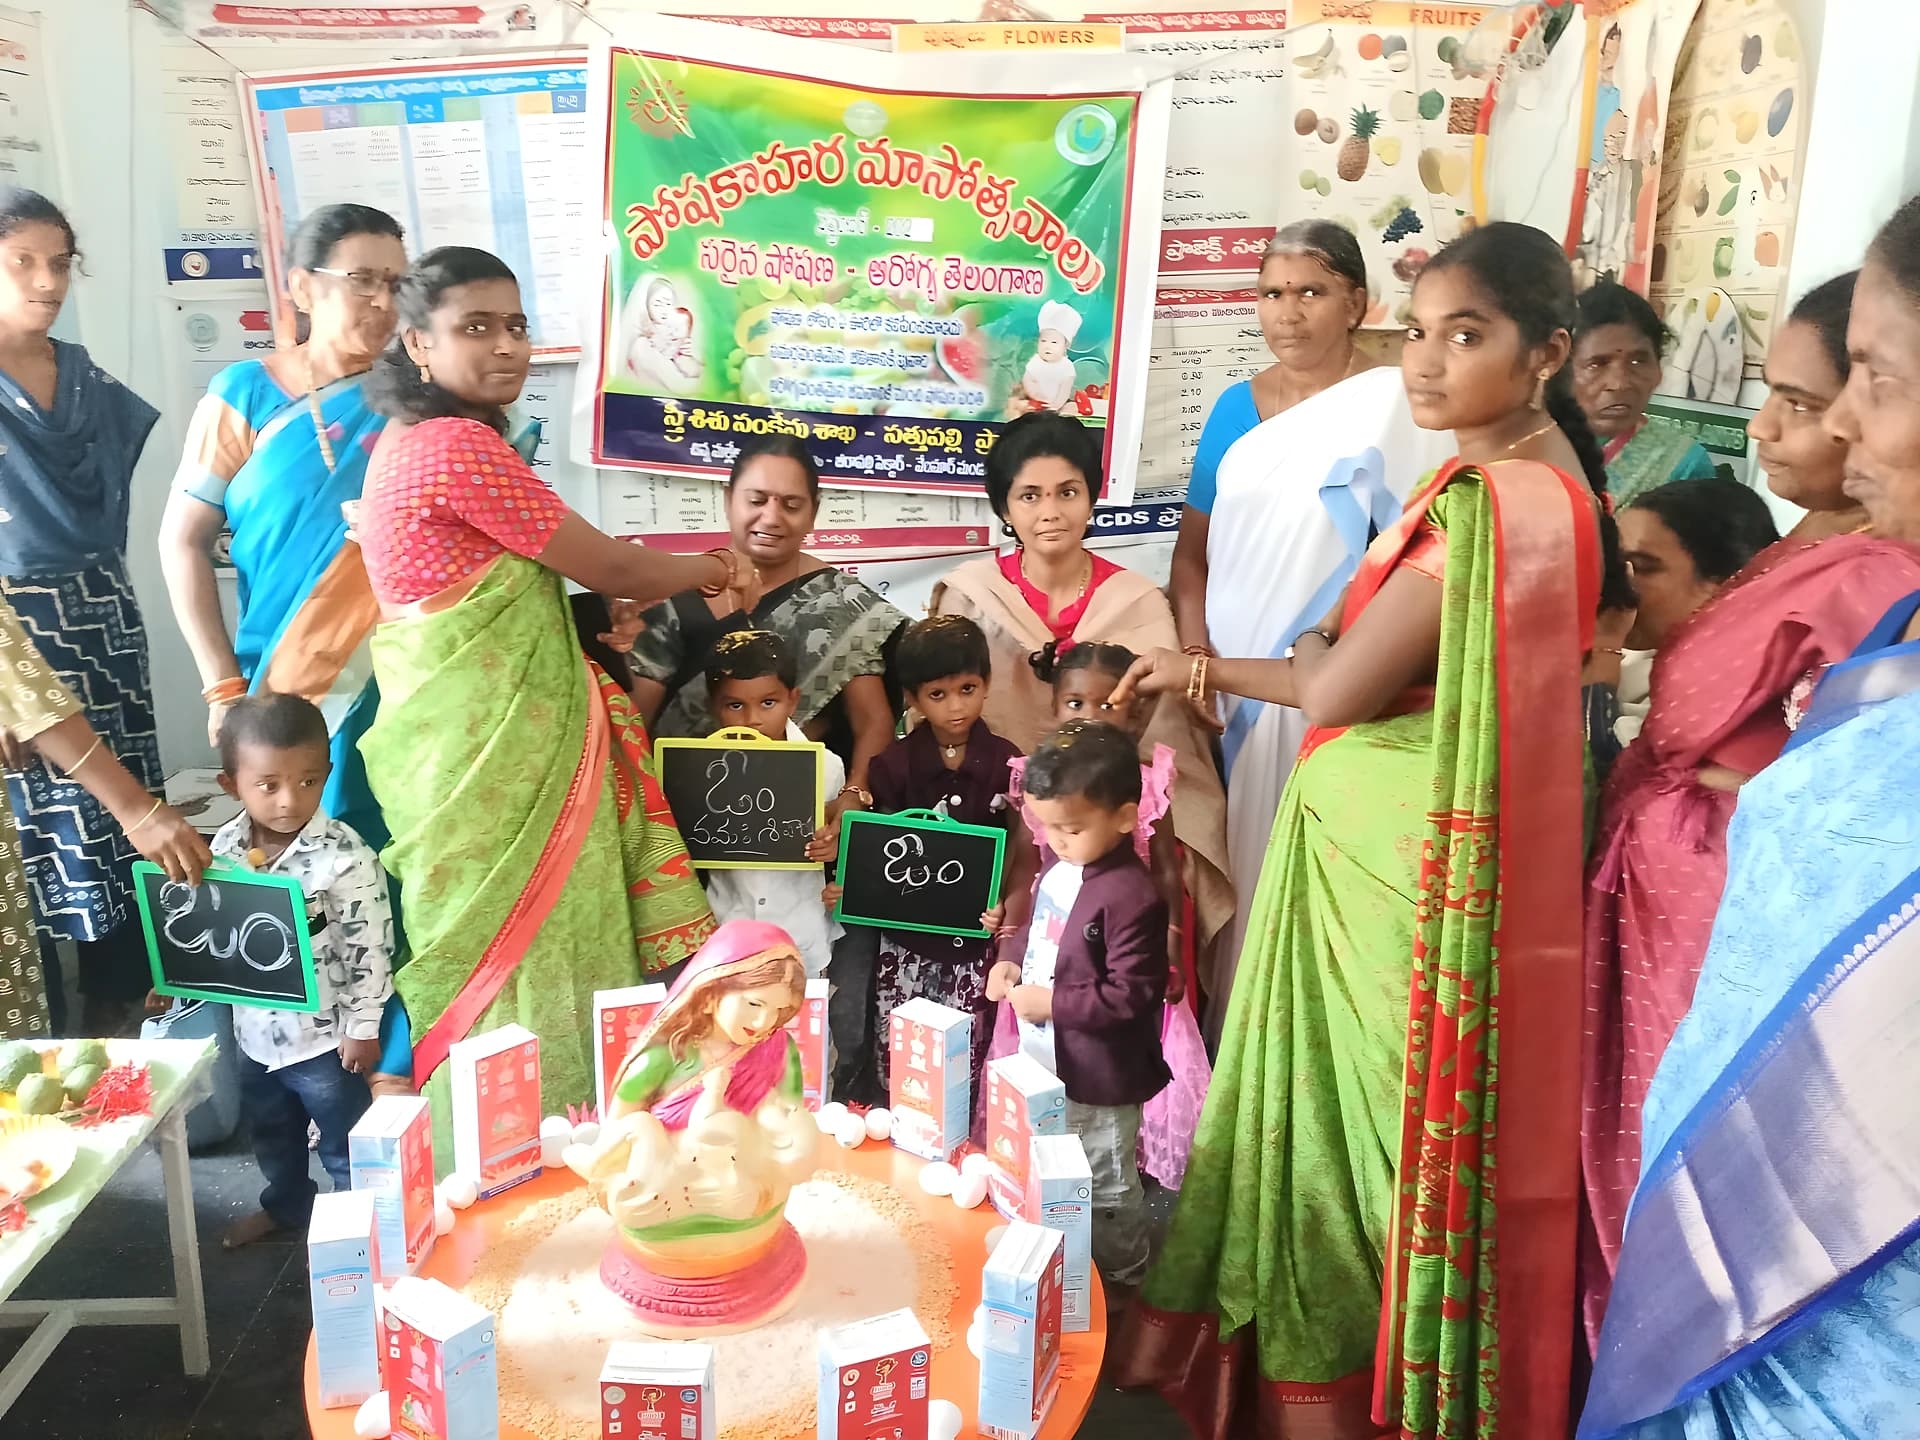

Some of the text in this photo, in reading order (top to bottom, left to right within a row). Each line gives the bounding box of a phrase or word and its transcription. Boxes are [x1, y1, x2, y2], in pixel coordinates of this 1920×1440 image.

[1409, 8, 1482, 27] FRUITS
[1003, 30, 1095, 45] FLOWERS
[701, 238, 758, 285] సరైన
[868, 254, 938, 302] ఆరోగ్య
[943, 257, 1044, 295] తెలంగాణ
